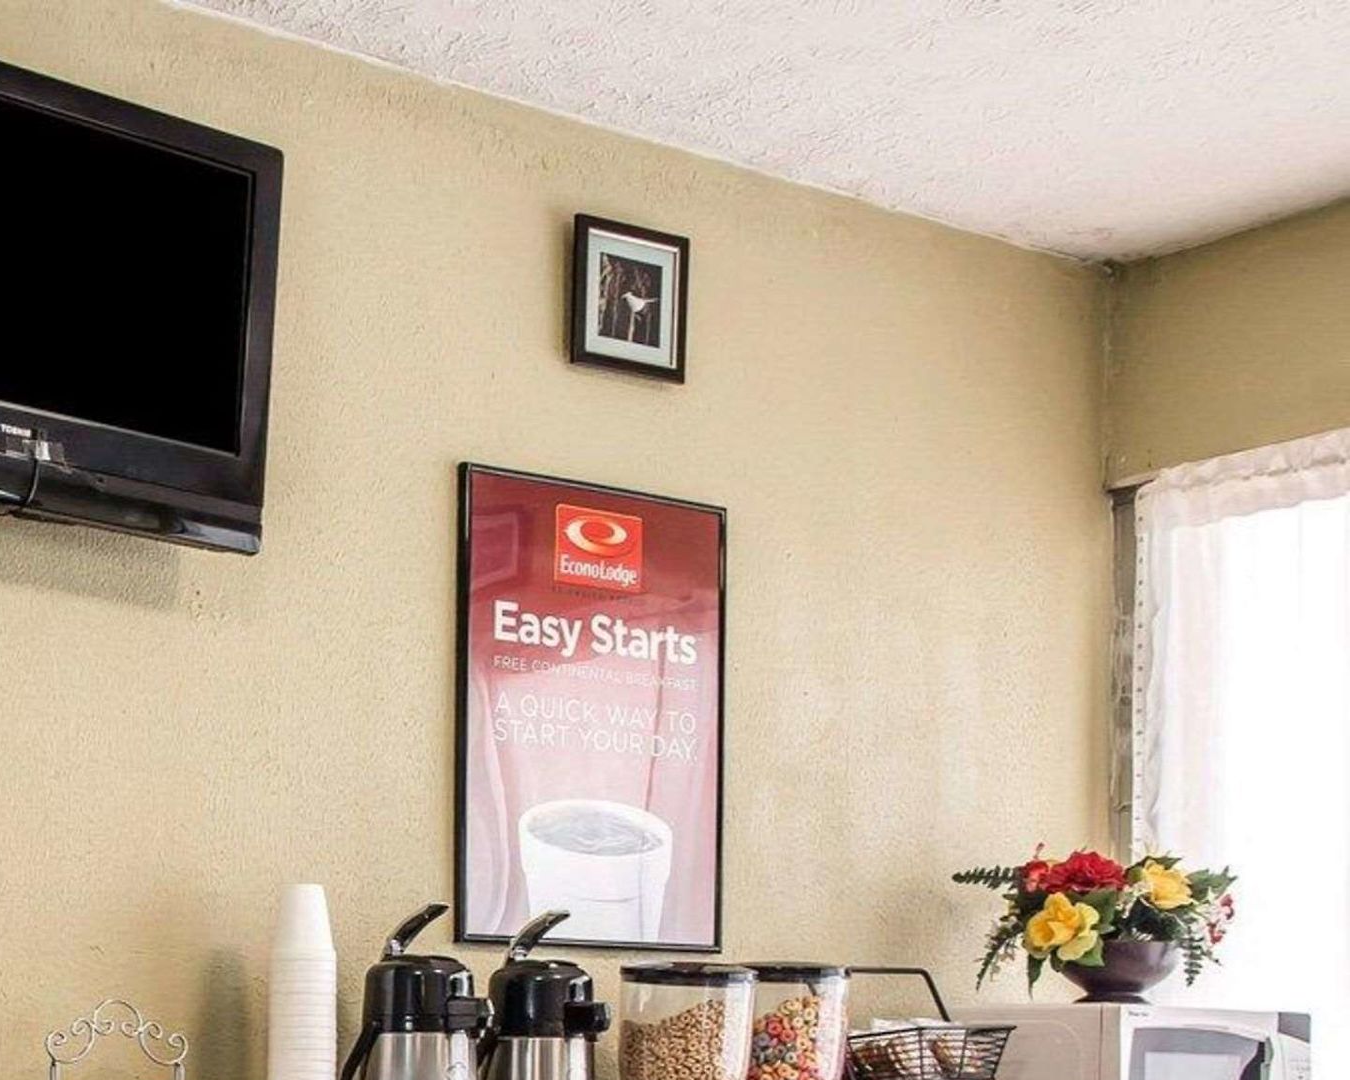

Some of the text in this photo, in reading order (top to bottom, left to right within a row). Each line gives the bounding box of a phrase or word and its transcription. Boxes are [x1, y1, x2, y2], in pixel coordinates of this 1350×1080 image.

[494, 600, 698, 665] Easy Starts
[492, 655, 528, 672] FREE
[495, 691, 697, 735] A QUICK WAY TO
[493, 718, 571, 746] START
[578, 728, 643, 755] YOUR
